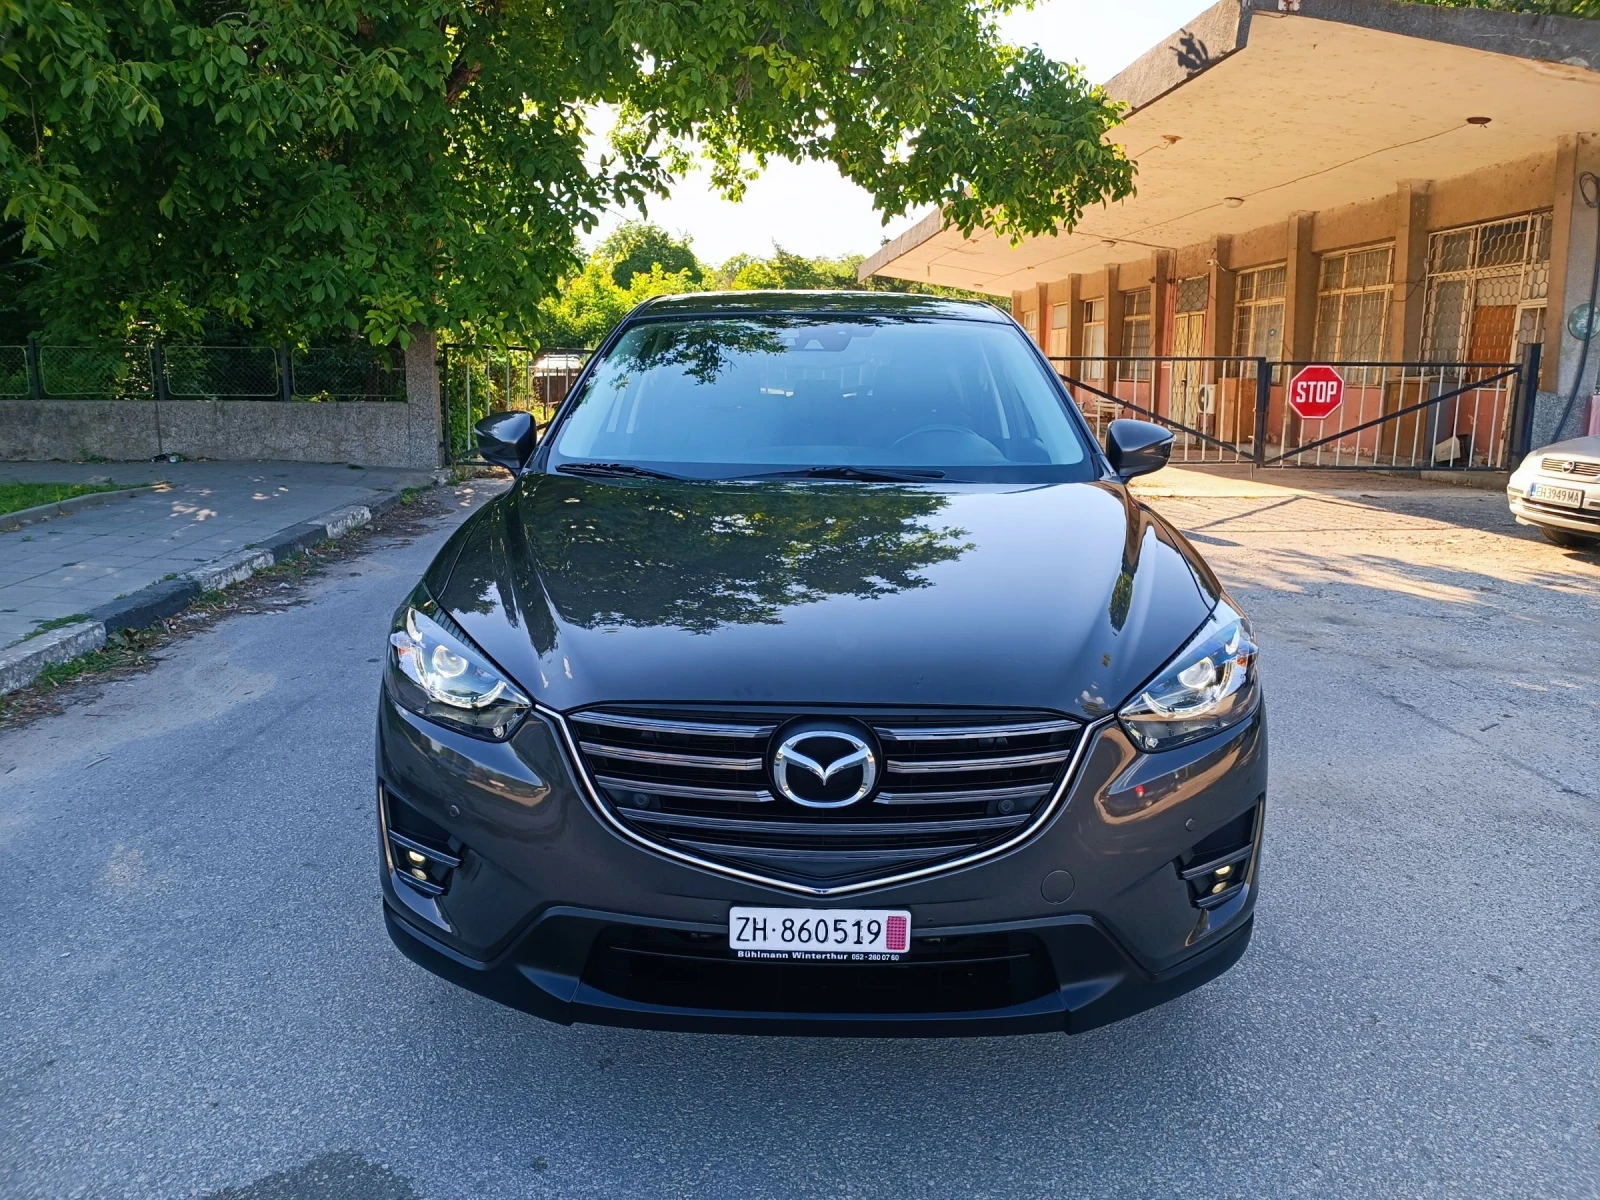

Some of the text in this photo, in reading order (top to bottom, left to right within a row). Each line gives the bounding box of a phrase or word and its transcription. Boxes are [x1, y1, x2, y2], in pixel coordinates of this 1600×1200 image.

[1296, 381, 1338, 403] STOP
[737, 950, 789, 959] Bühlmann
[792, 951, 849, 960] Winterthur
